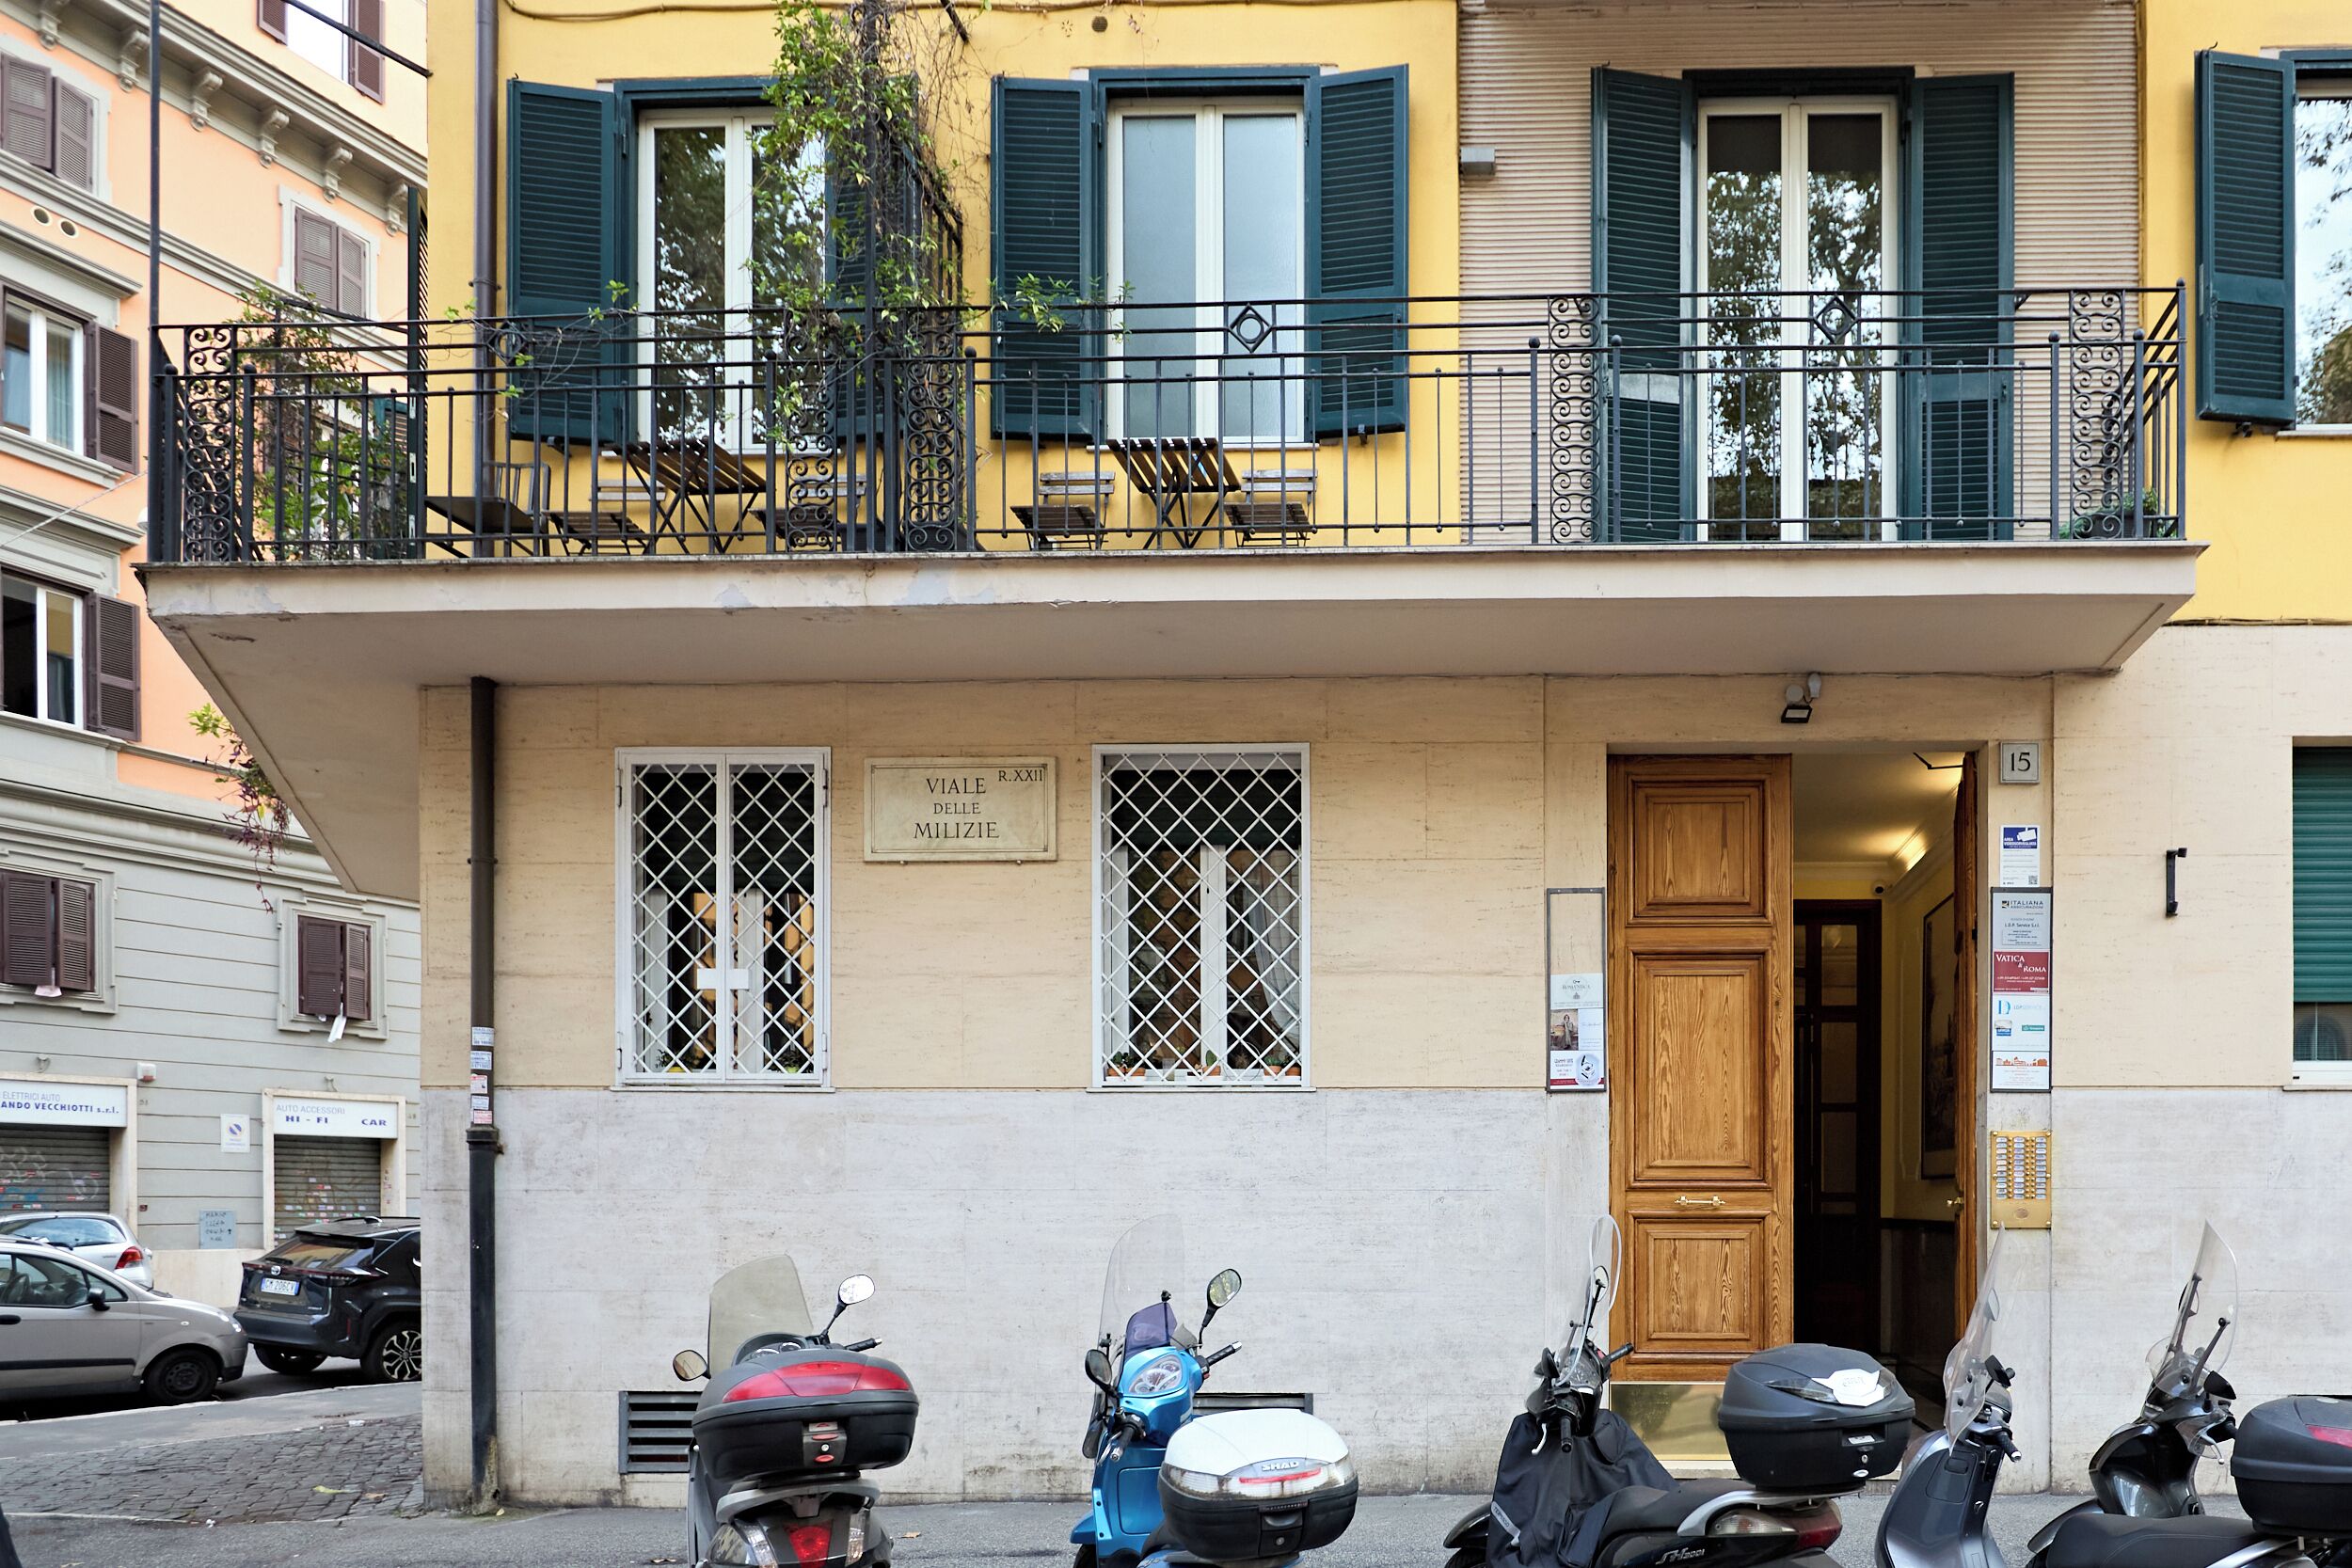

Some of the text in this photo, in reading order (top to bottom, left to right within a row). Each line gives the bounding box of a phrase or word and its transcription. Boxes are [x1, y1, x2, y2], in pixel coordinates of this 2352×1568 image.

[2010, 752, 2031, 772] 15
[997, 769, 1043, 783] R.XXII
[926, 777, 987, 795] VIALE
[933, 802, 982, 815] DELLE
[914, 821, 1000, 839] MILIZIE
[1995, 954, 2025, 962] VATICA
[3, 1091, 60, 1101] ELETTRICI AUTO
[34, 1102, 93, 1113] VECCHIOTTI
[276, 1104, 345, 1115] AUTO ACCESSORI
[361, 1118, 387, 1127] CAR
[1261, 1461, 1300, 1472] SHAD
